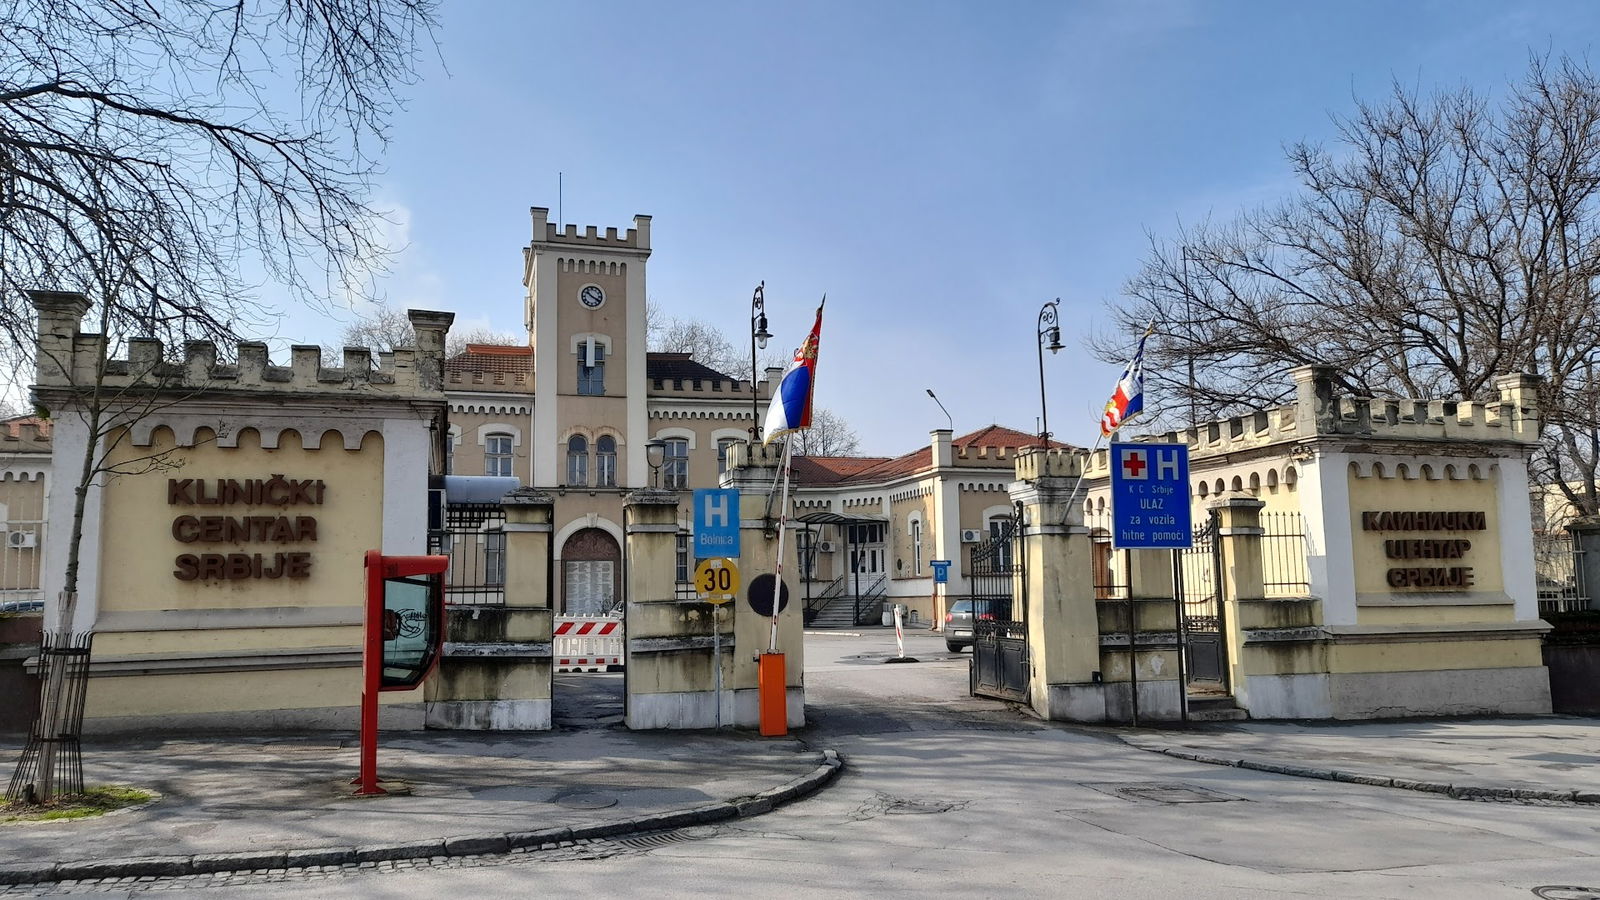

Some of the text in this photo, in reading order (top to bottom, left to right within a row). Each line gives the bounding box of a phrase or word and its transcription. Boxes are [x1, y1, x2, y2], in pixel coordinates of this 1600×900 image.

[1157, 449, 1179, 480] H
[167, 473, 325, 505] KLINIČKI
[1151, 485, 1174, 496] Srbije
[704, 494, 729, 527] H
[1140, 498, 1164, 510] ULAZ
[172, 515, 317, 543] CENTAR
[1130, 514, 1175, 525] za vozila
[1362, 511, 1487, 531] КЛИНИЧКИ
[700, 533, 734, 545] Bolnica
[1122, 529, 1184, 543] hitne pomoći
[1385, 540, 1471, 558] ЦЕНТАР
[173, 552, 311, 581] SRBIJE
[704, 568, 731, 592] 30
[1387, 567, 1474, 587] СРБИЈЕ
